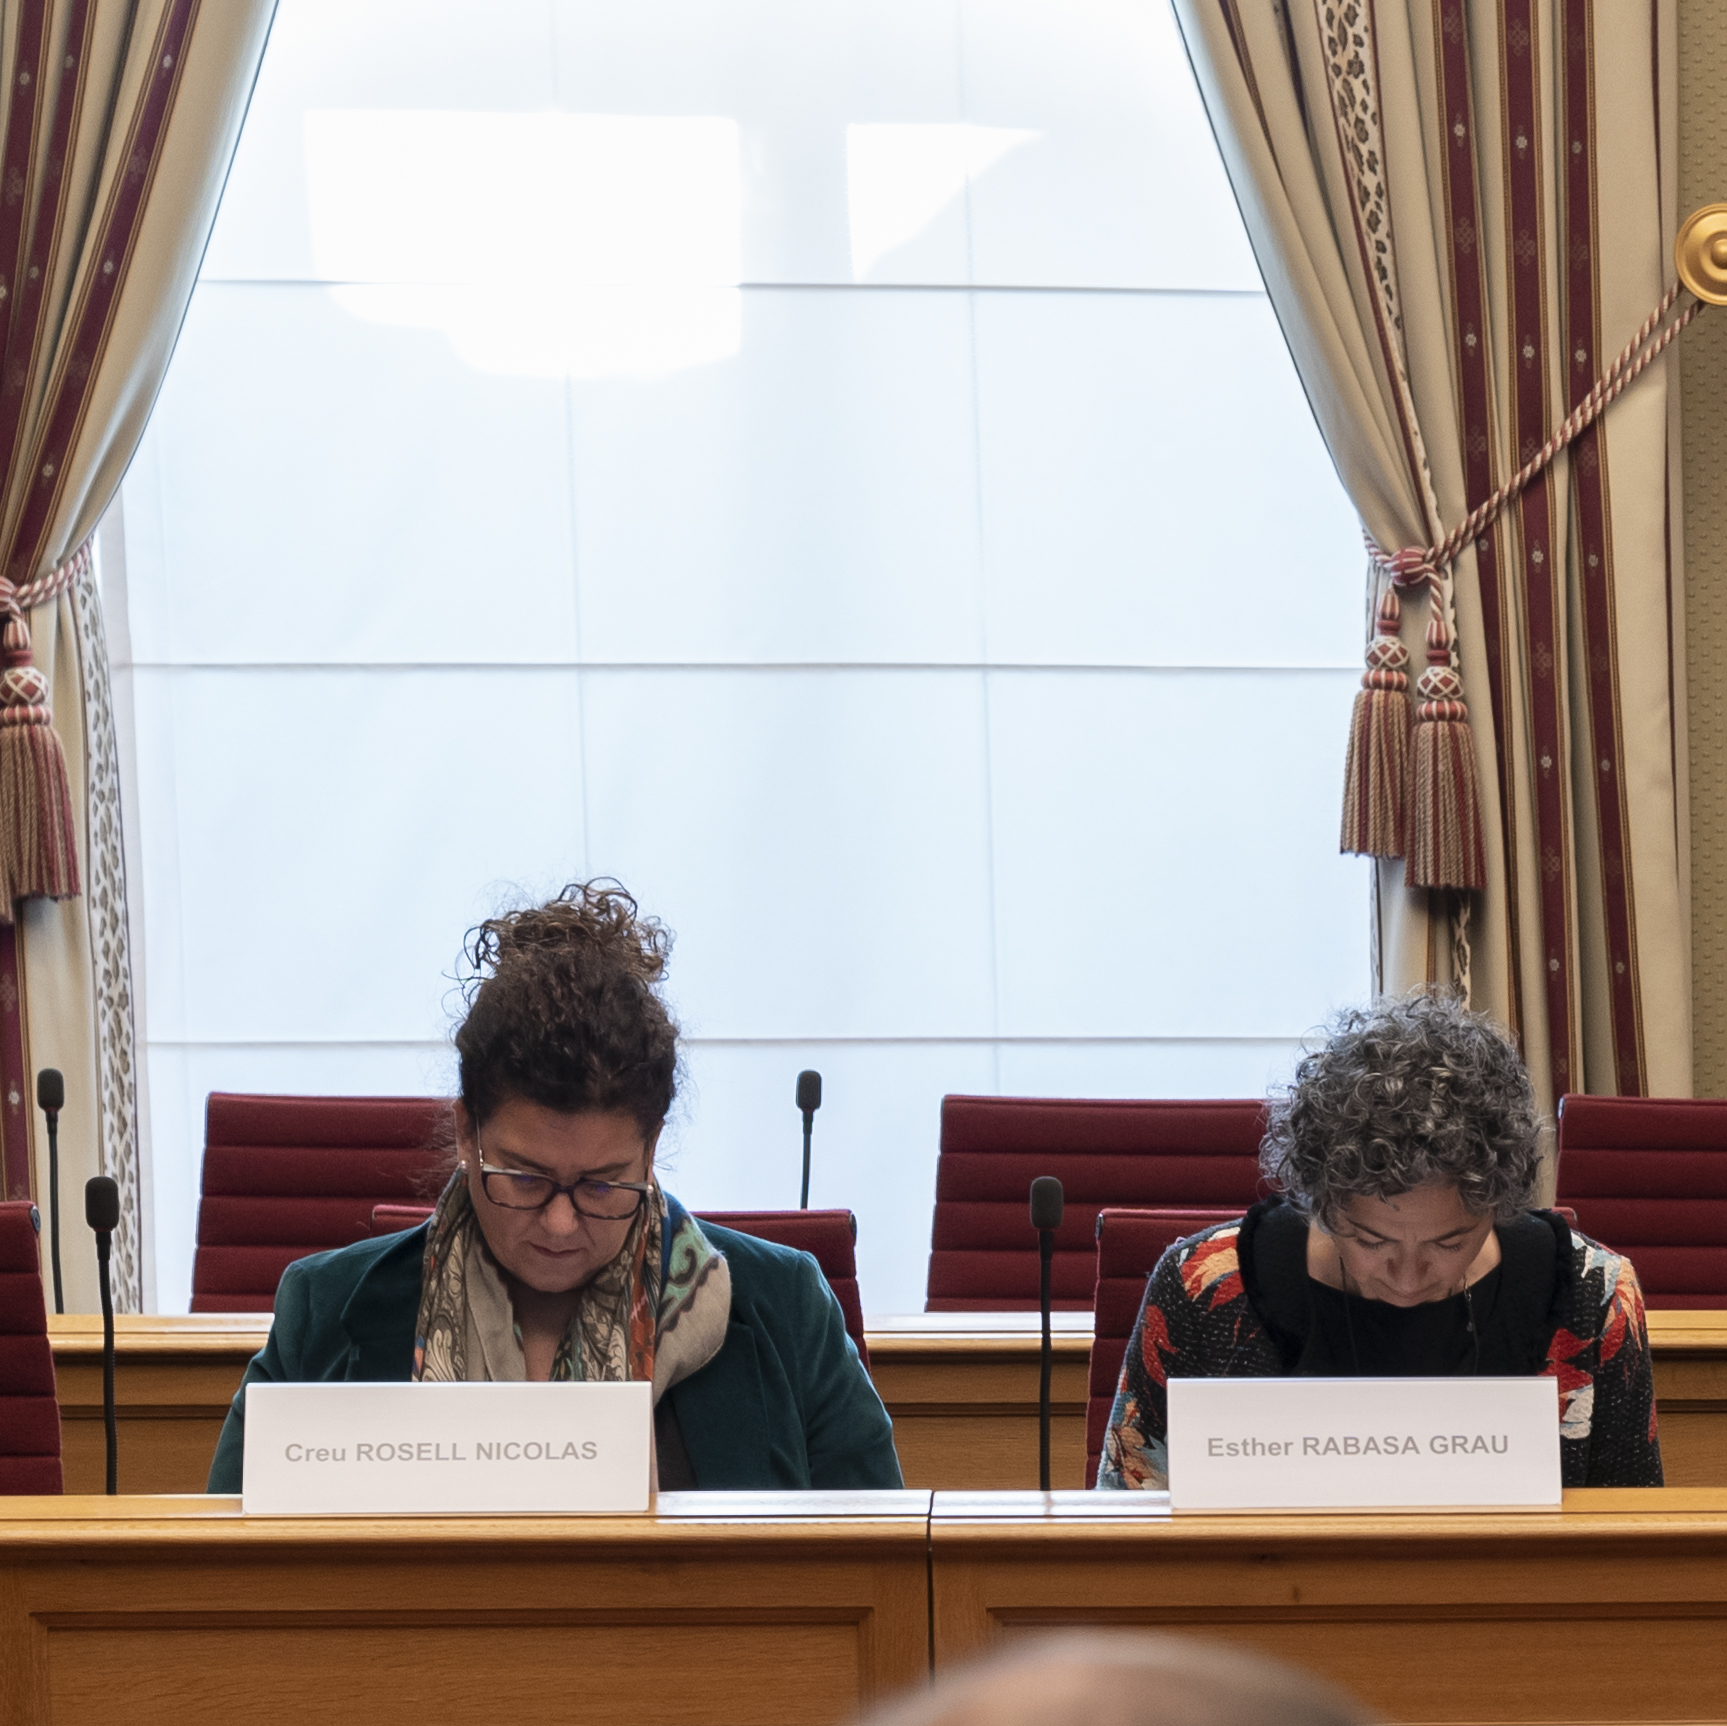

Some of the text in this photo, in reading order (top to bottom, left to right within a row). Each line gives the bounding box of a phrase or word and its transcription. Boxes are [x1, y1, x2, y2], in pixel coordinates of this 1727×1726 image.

[284, 1441, 598, 1462] Creu ROSELL NICOLAS
[1207, 1435, 1508, 1456] Esther RABASA GRAU
